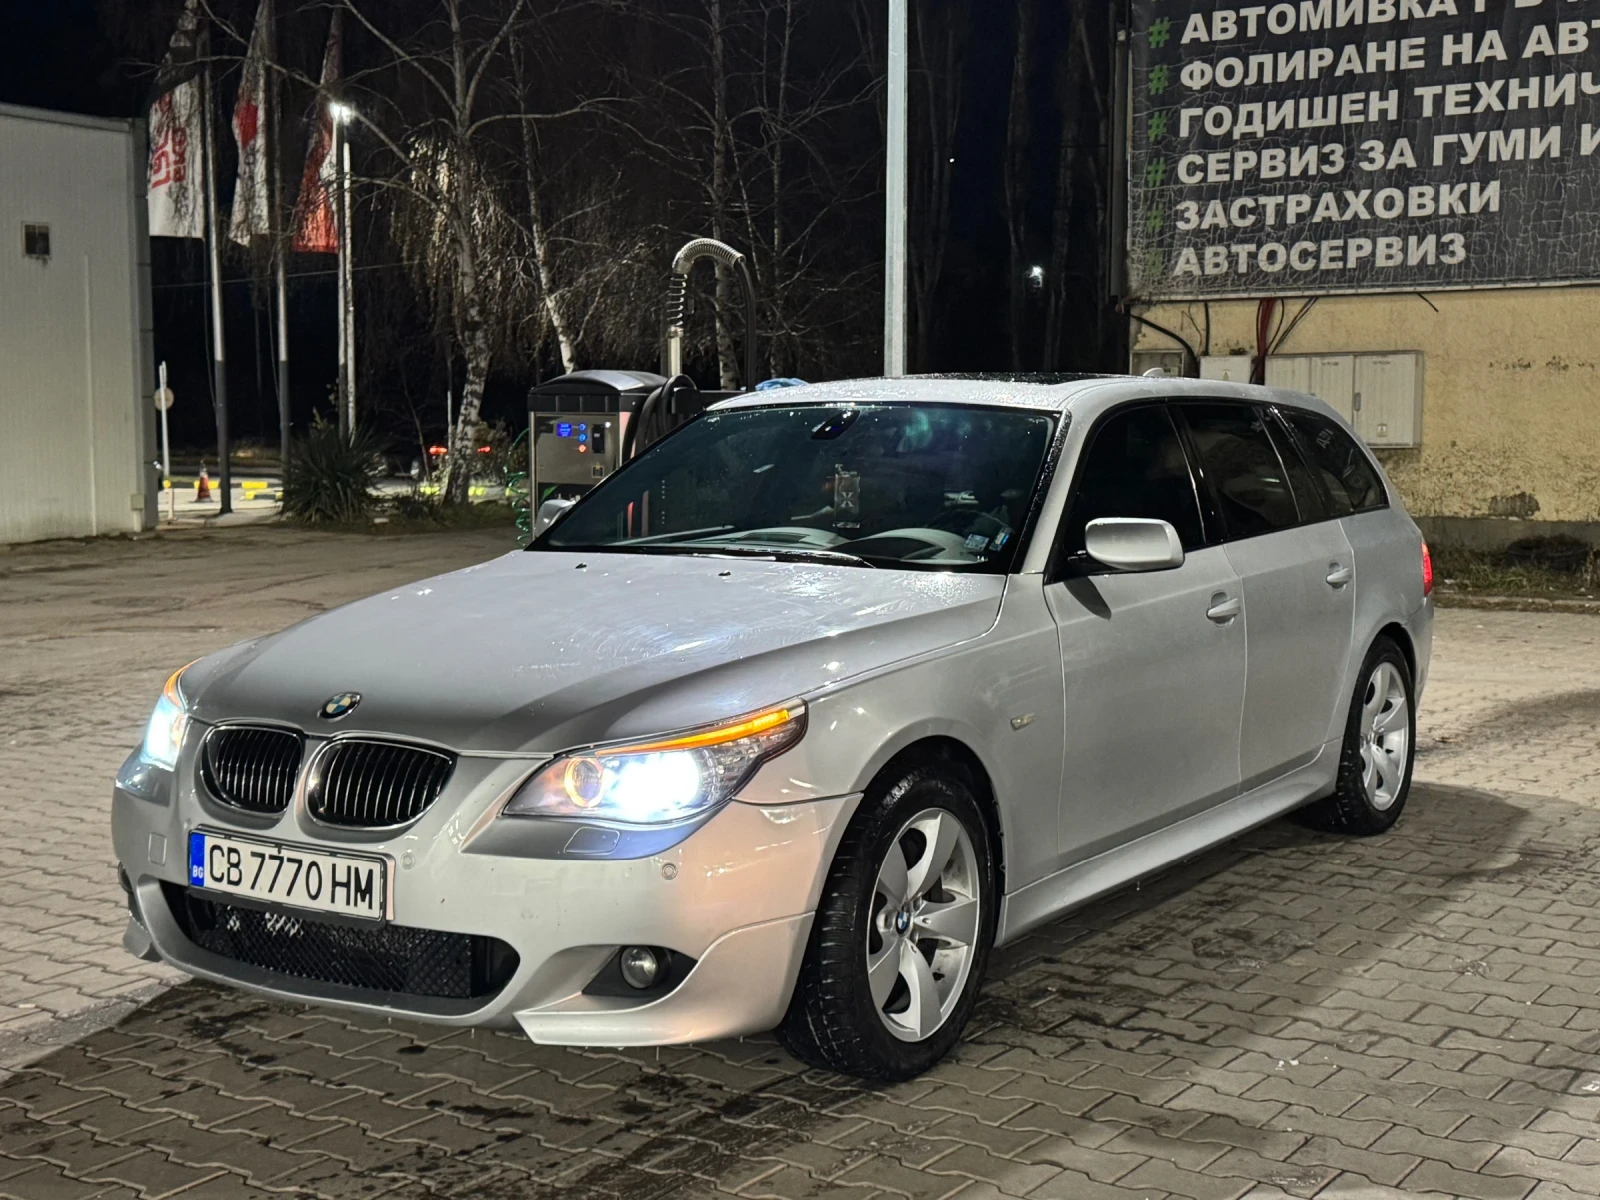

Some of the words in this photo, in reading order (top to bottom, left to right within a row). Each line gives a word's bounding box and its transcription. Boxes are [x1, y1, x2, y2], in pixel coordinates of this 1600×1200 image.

[1181, 37, 1426, 90] ФОЛИРАНЕ
[1443, 30, 1508, 66] НА
[1180, 90, 1399, 140] ГОДИШЕН
[1178, 143, 1345, 184] СЕРВИЗ
[1359, 138, 1417, 171] ЗА
[1433, 126, 1561, 166] ГУМИ
[1176, 180, 1501, 231] ЗАСТРАХОВКИ
[1173, 233, 1466, 277] АВТОСЕРВИЗ
